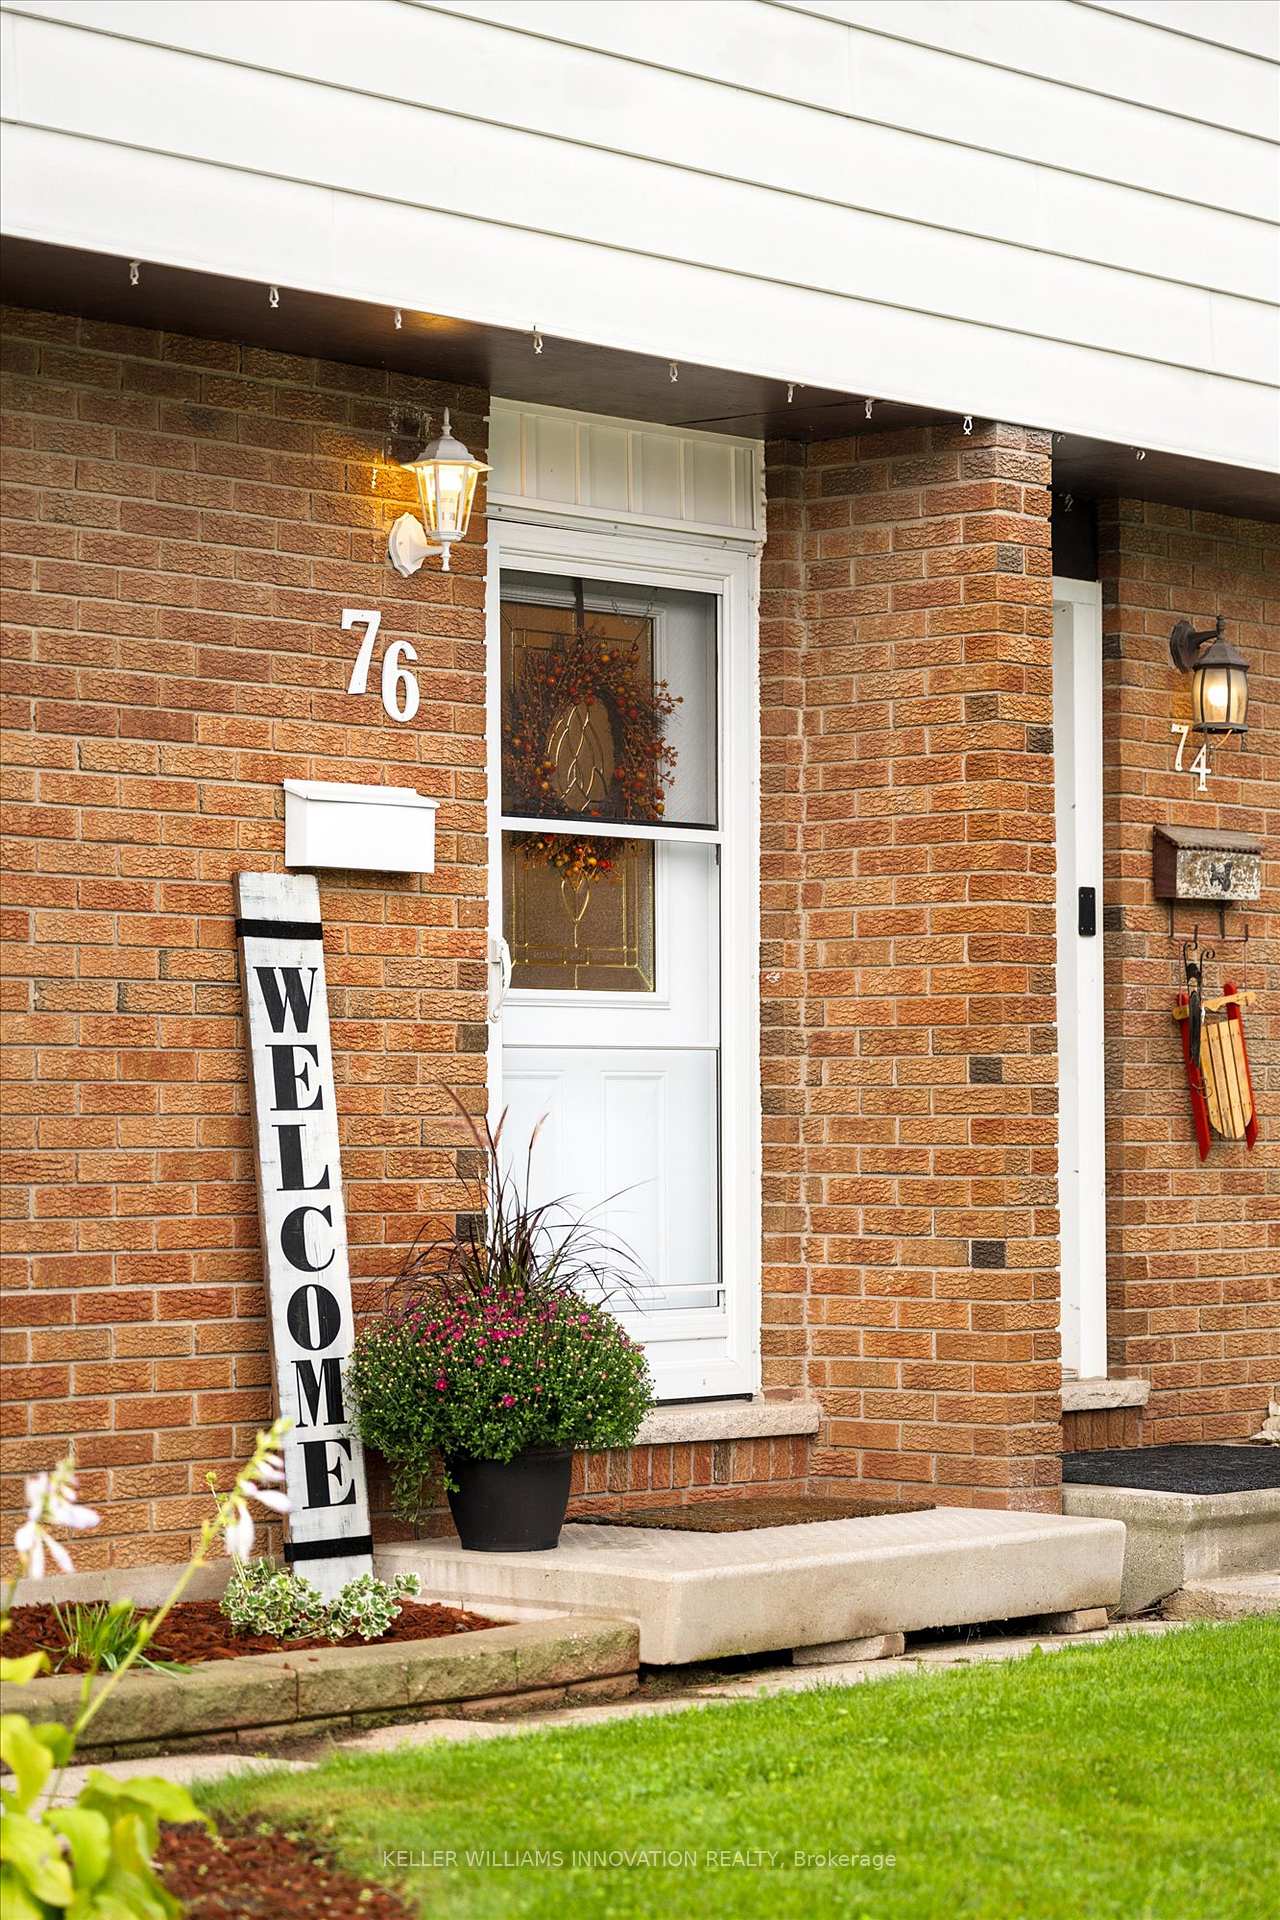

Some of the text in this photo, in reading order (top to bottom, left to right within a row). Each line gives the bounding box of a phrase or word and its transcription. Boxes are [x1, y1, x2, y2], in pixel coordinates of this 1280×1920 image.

[341, 608, 420, 723] 76
[1170, 723, 1212, 792] 74
[252, 965, 357, 1510] WELCOME
